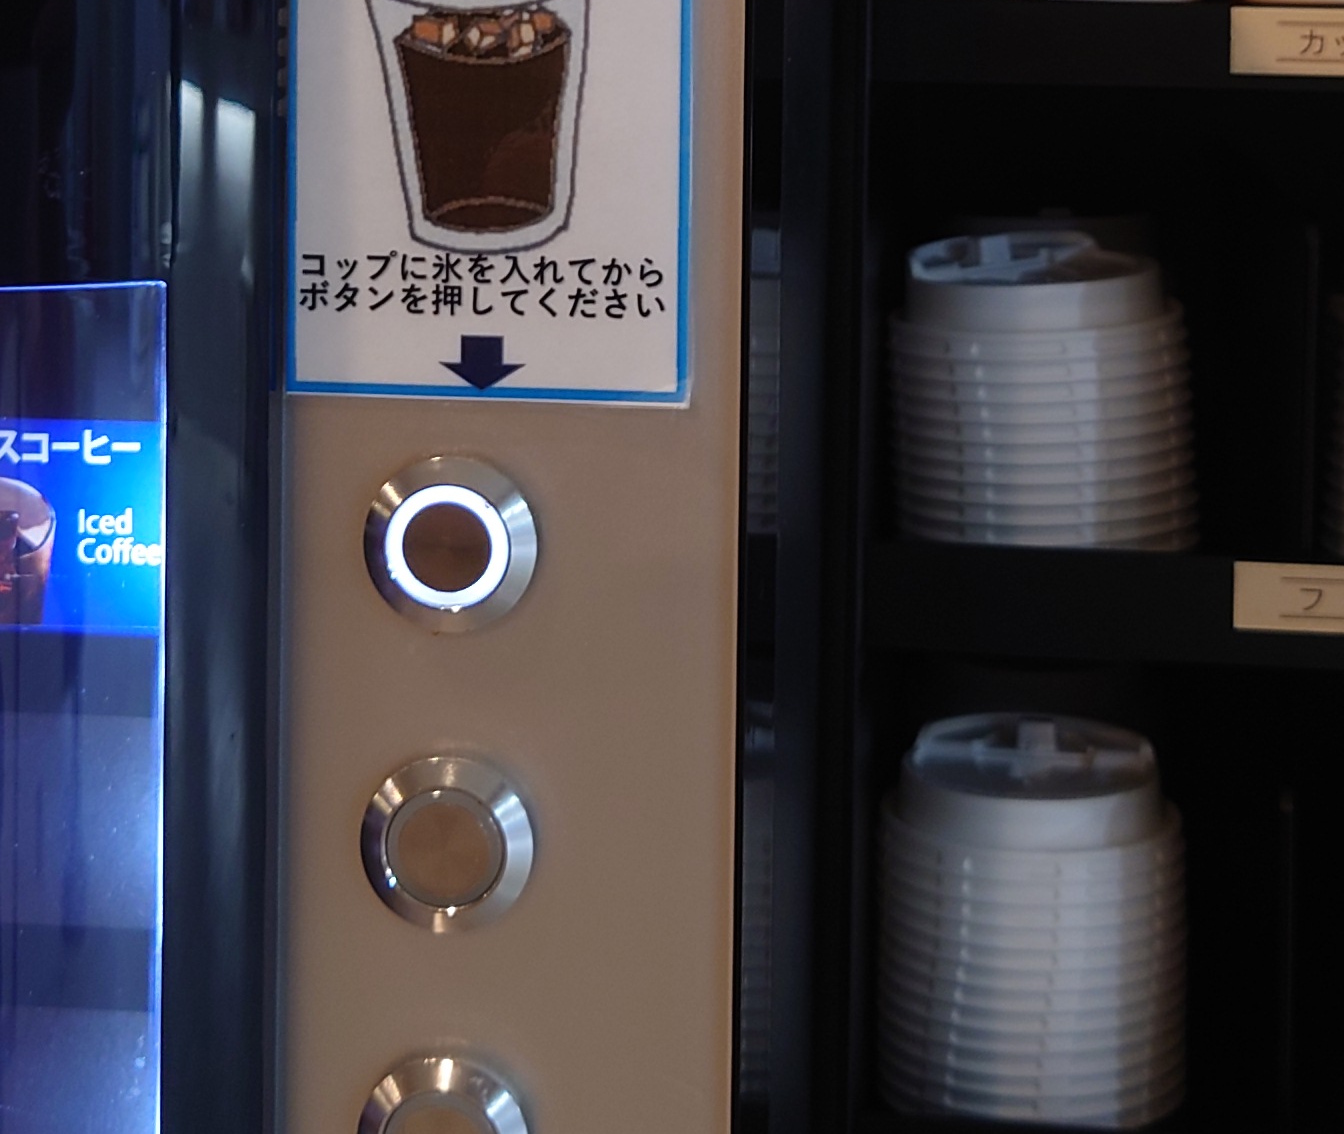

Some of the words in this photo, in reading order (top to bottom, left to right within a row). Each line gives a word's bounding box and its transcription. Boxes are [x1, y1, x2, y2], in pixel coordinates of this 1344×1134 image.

[300, 250, 665, 286] コップに氷を入れてから
[298, 283, 667, 320] ボタンを押してください
[78, 508, 134, 536] Iced
[76, 537, 162, 568] Coffee
